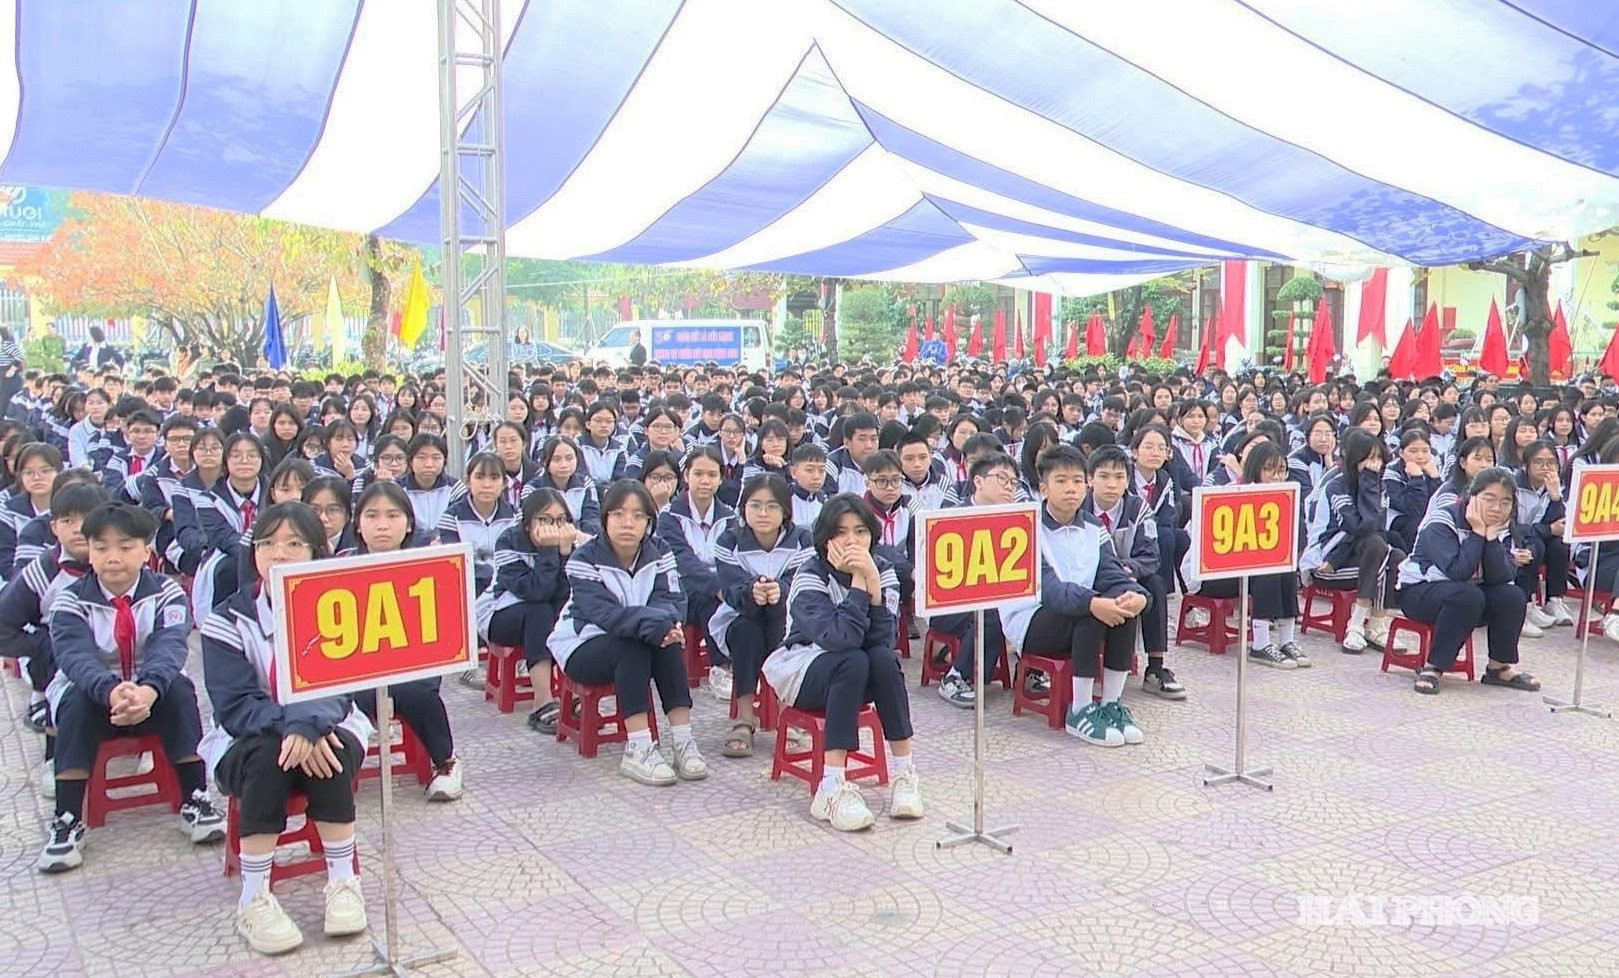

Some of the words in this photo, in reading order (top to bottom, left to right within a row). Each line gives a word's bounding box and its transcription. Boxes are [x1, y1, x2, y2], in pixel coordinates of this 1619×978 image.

[934, 526, 1029, 590] 9A2
[1212, 501, 1280, 555] 9A3
[316, 577, 439, 660] 9A1
